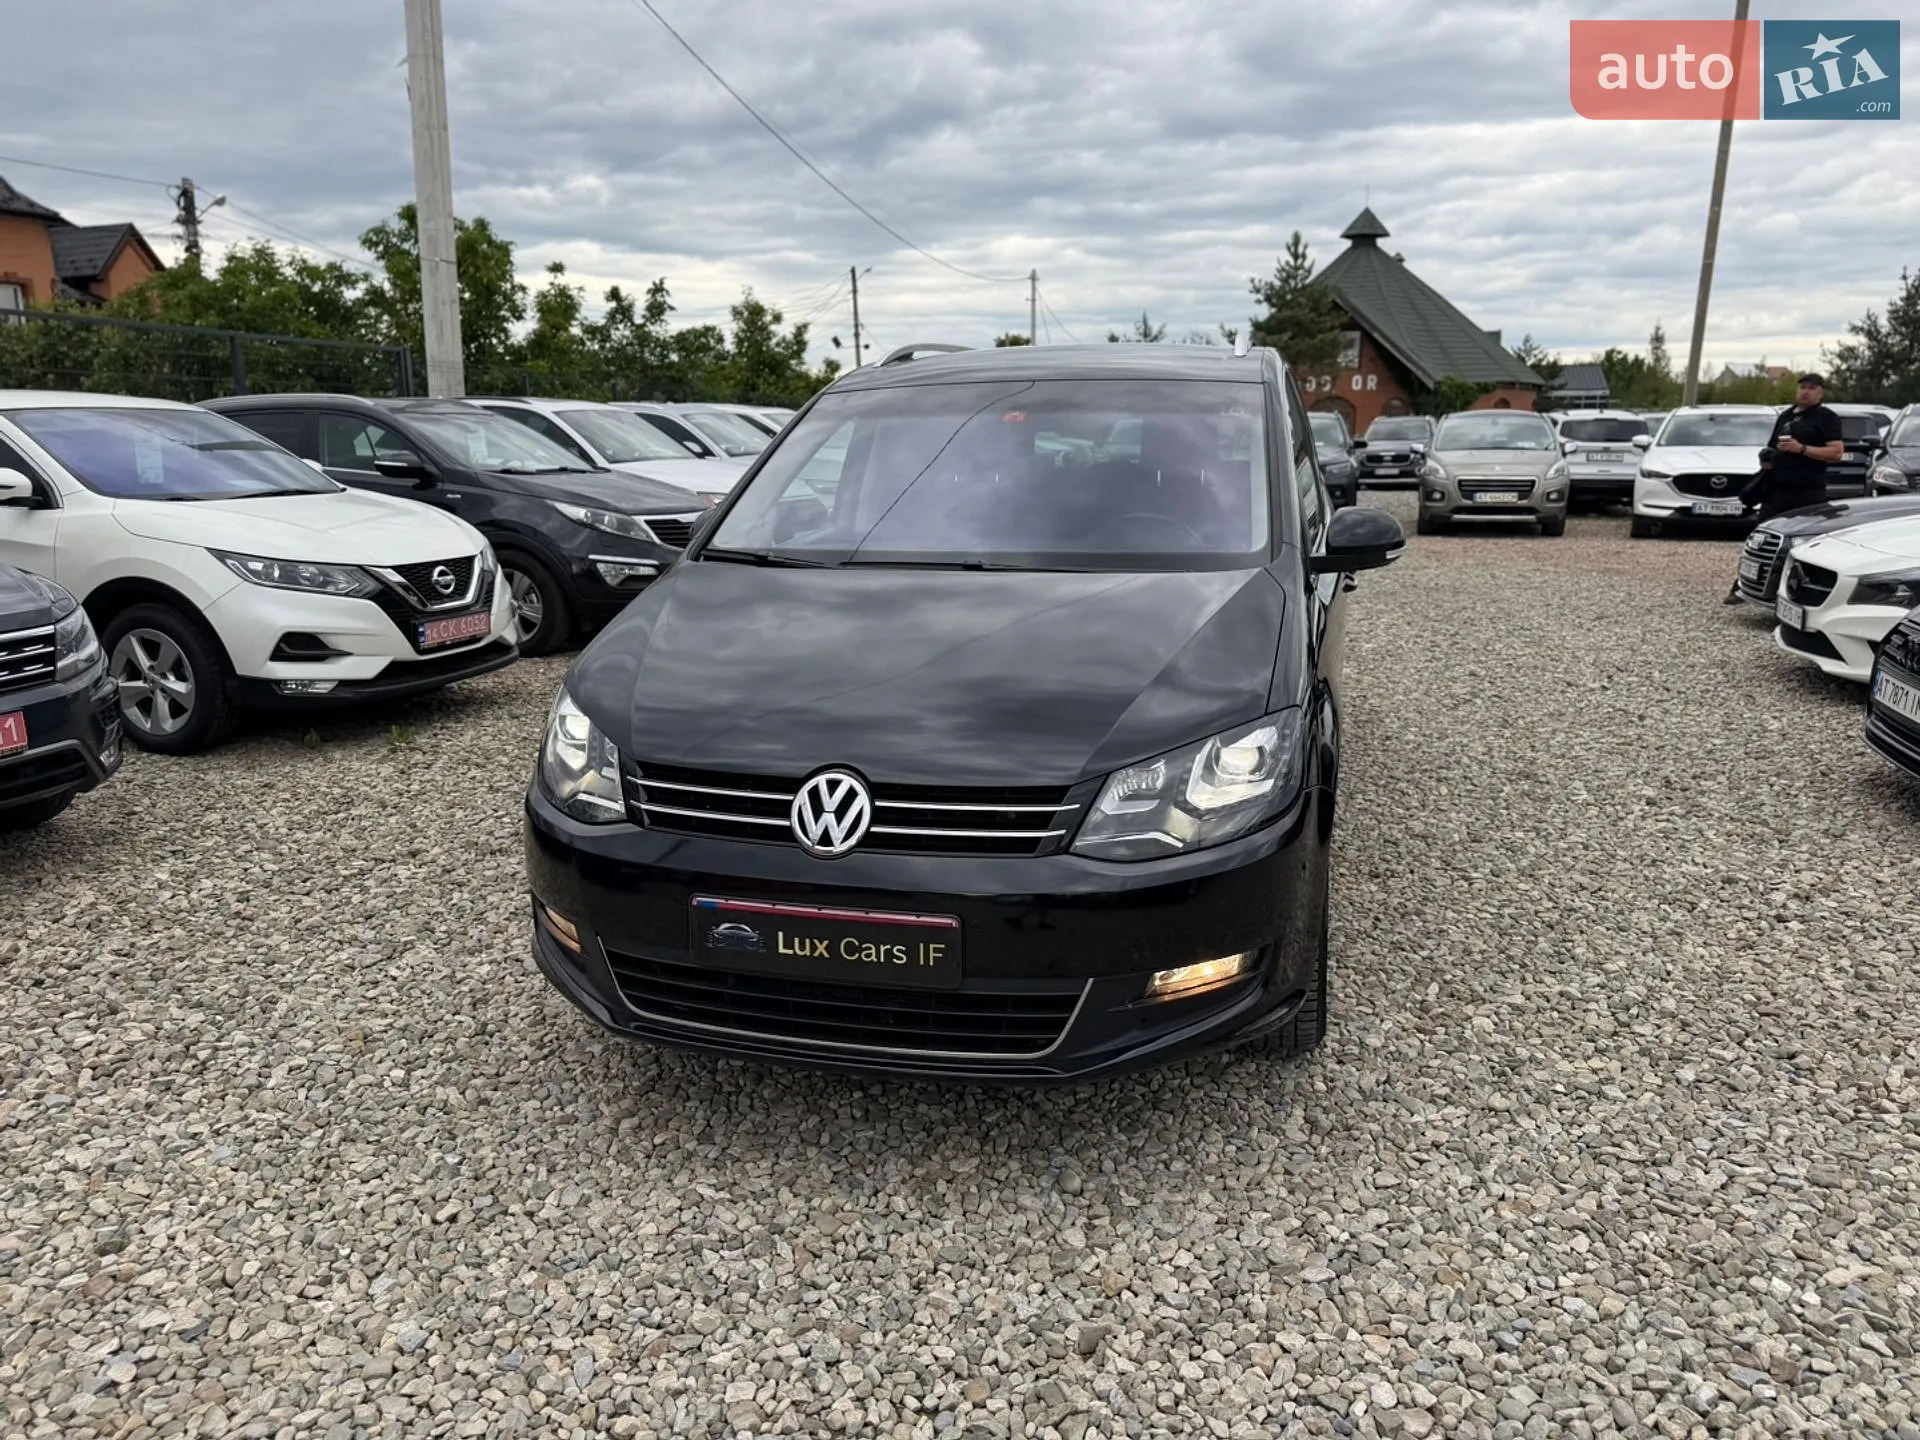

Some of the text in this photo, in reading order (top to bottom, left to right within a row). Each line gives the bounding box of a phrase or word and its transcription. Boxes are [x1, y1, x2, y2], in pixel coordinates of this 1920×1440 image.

[439, 620, 458, 637] CK
[777, 931, 946, 966] Lux Cars IF
